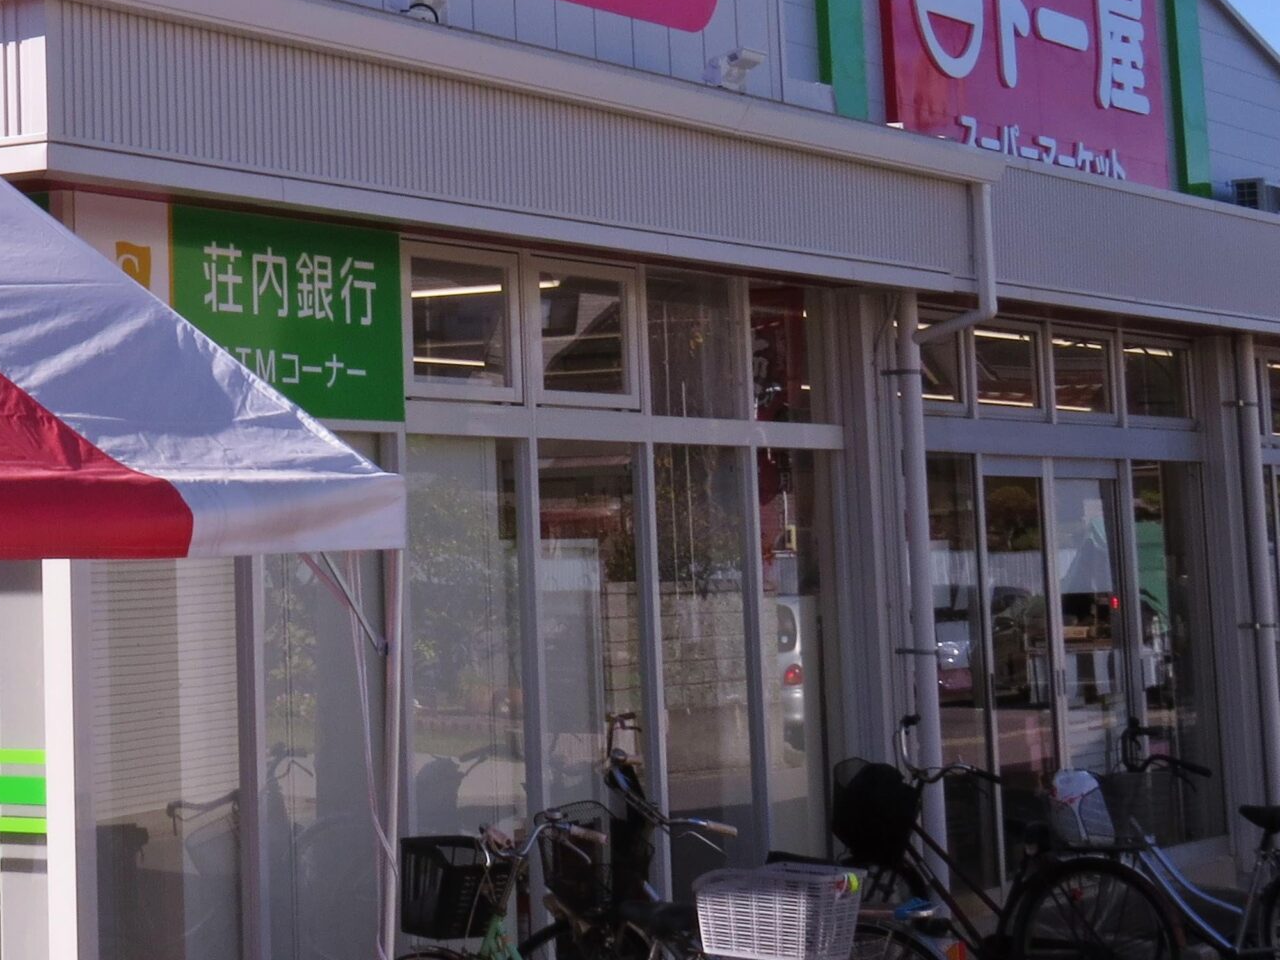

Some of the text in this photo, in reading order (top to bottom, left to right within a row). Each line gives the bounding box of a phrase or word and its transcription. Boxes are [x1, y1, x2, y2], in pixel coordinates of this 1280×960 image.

[958, 115, 1127, 180] スーパーマーケット
[202, 240, 377, 327] 荘内銀行
[225, 345, 367, 388] TMコーナー
